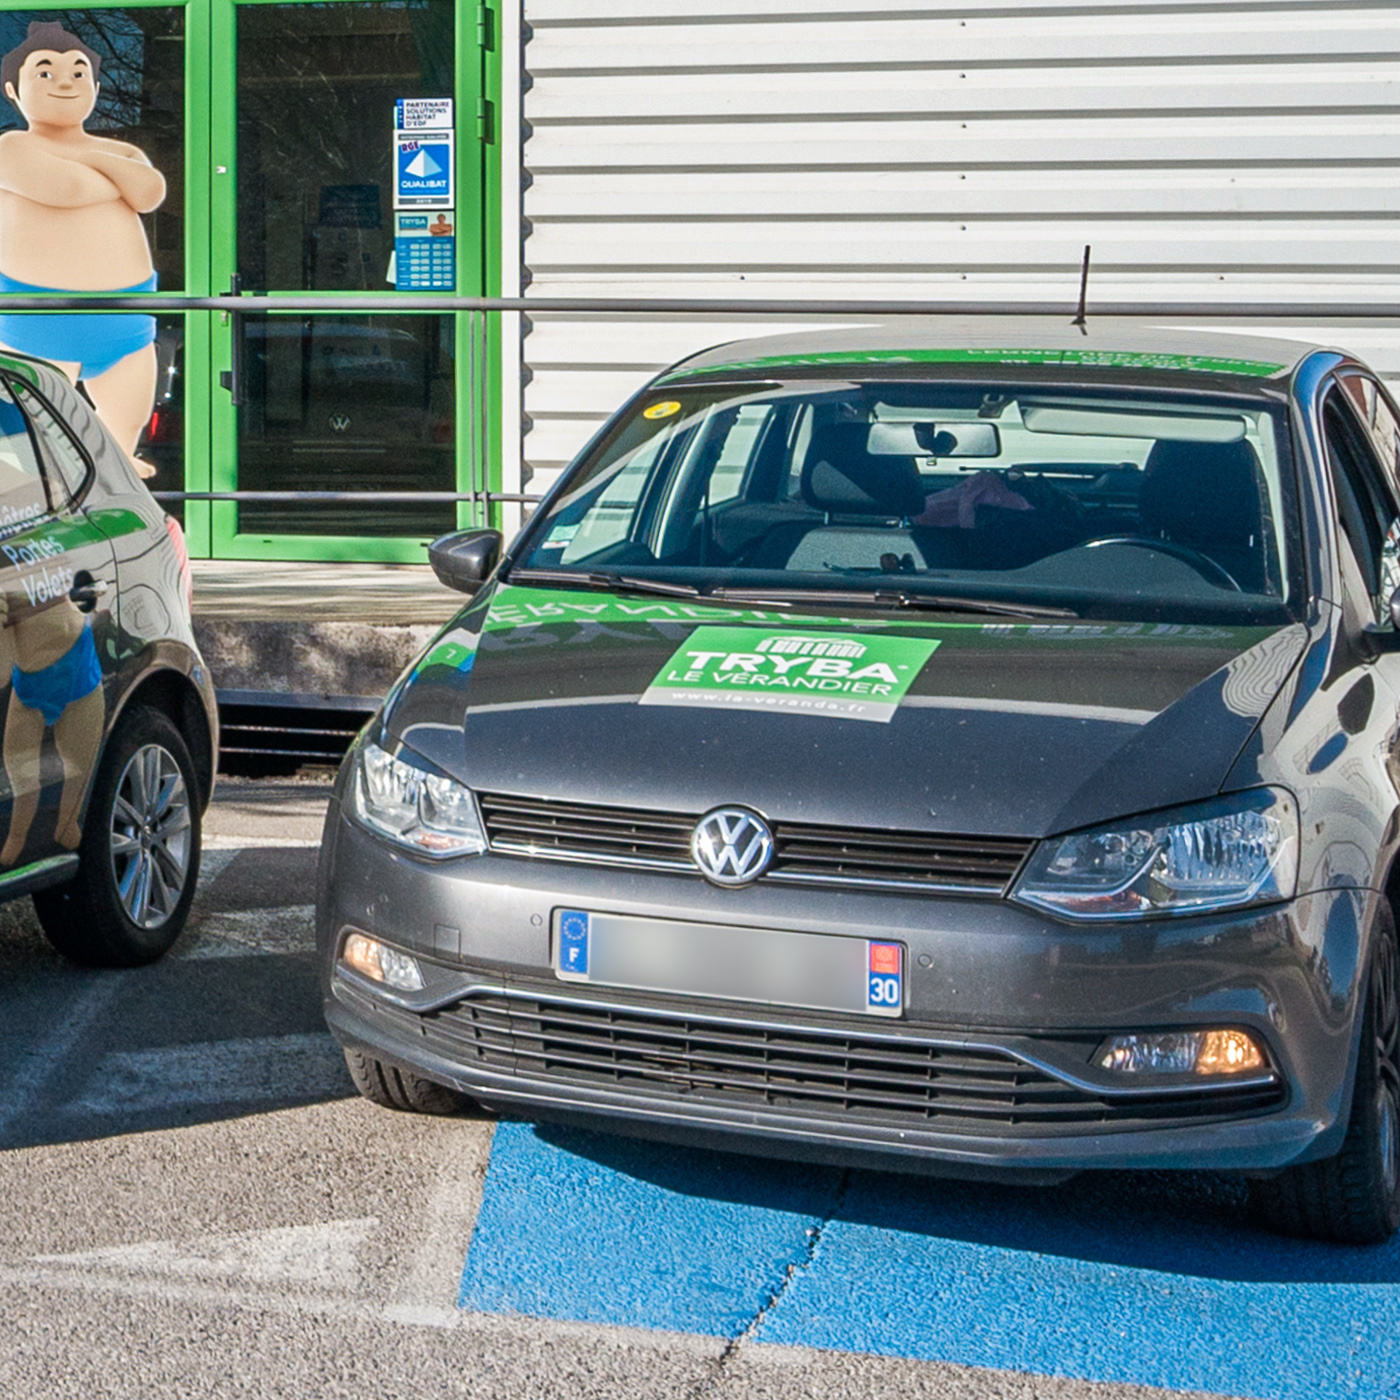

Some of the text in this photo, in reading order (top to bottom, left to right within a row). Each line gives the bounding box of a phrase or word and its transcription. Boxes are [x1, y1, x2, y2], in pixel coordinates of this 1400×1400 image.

[401, 141, 419, 152] RGE
[401, 180, 447, 188] QUALIBAT
[1, 536, 65, 572] Portes
[21, 566, 74, 607] Volets
[686, 651, 899, 683] TRYBA
[667, 669, 893, 696] LE VÉRANDIER
[870, 977, 899, 1004] 30
